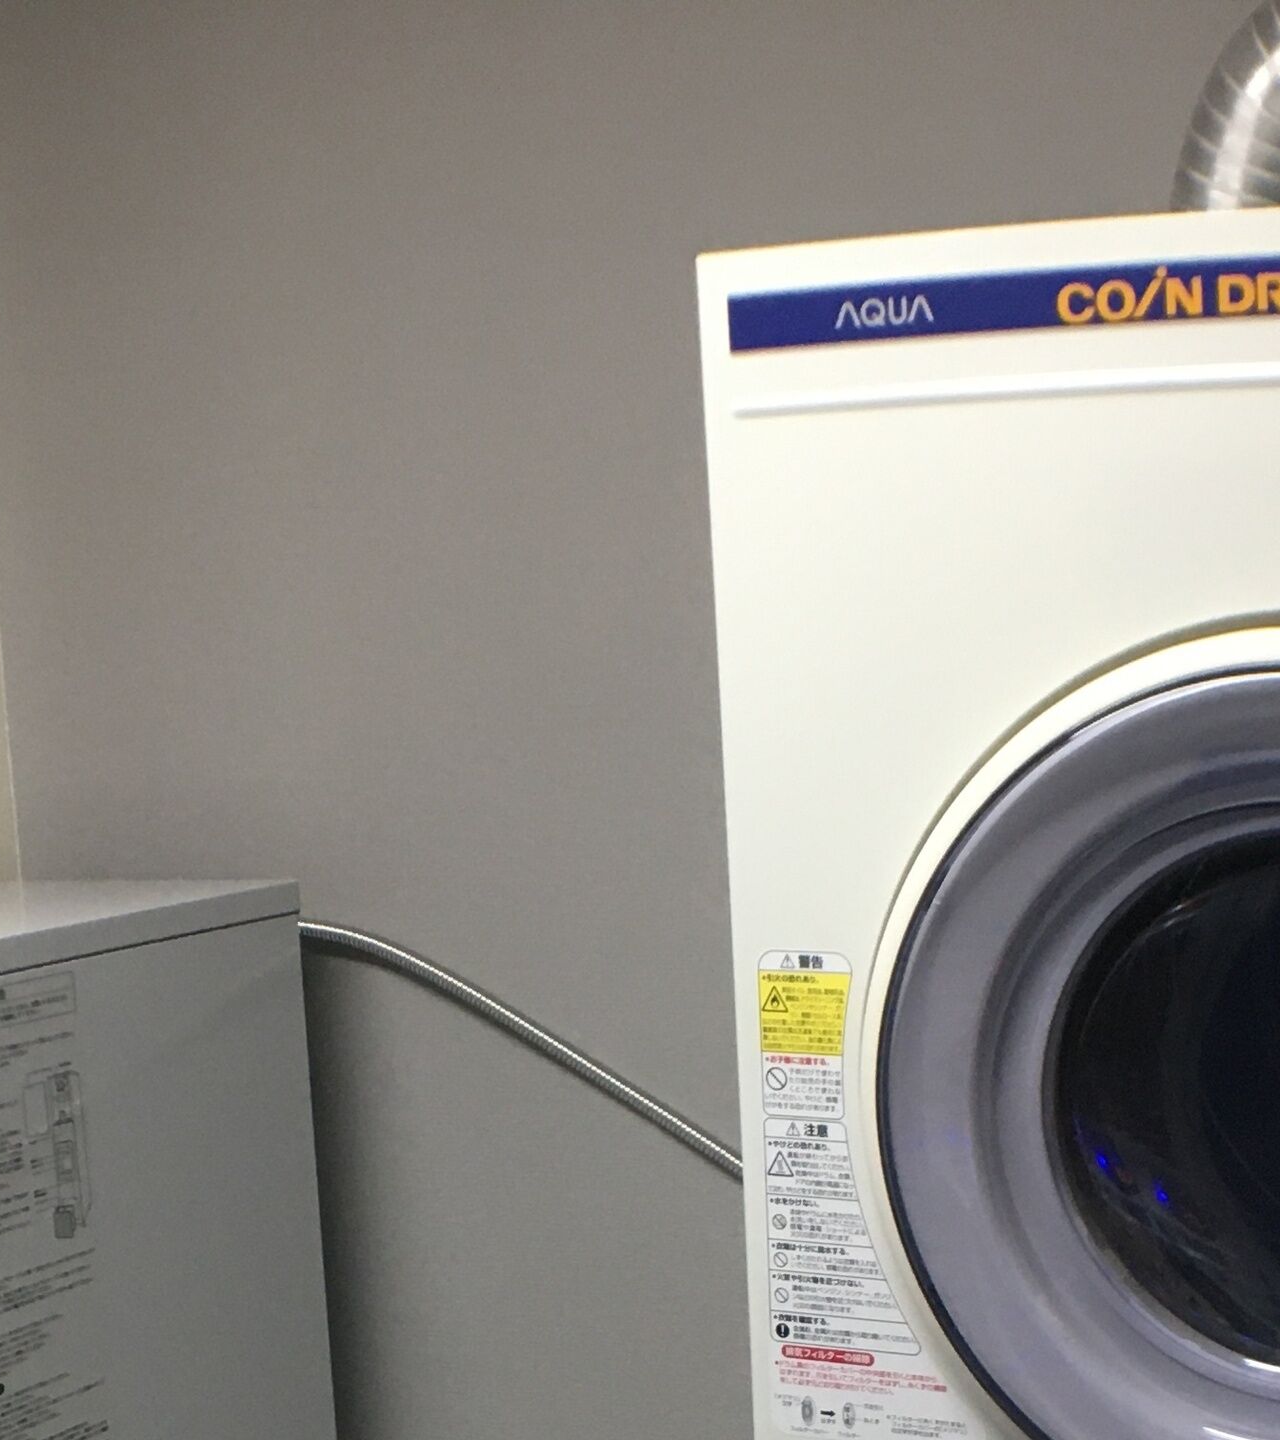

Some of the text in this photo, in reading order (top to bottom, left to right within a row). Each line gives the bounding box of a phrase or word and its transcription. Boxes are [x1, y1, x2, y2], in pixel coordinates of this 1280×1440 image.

[1056, 265, 1203, 325] COIN
[834, 294, 934, 330] AQUA
[798, 954, 824, 970] 警告
[803, 1123, 829, 1138] 注意
